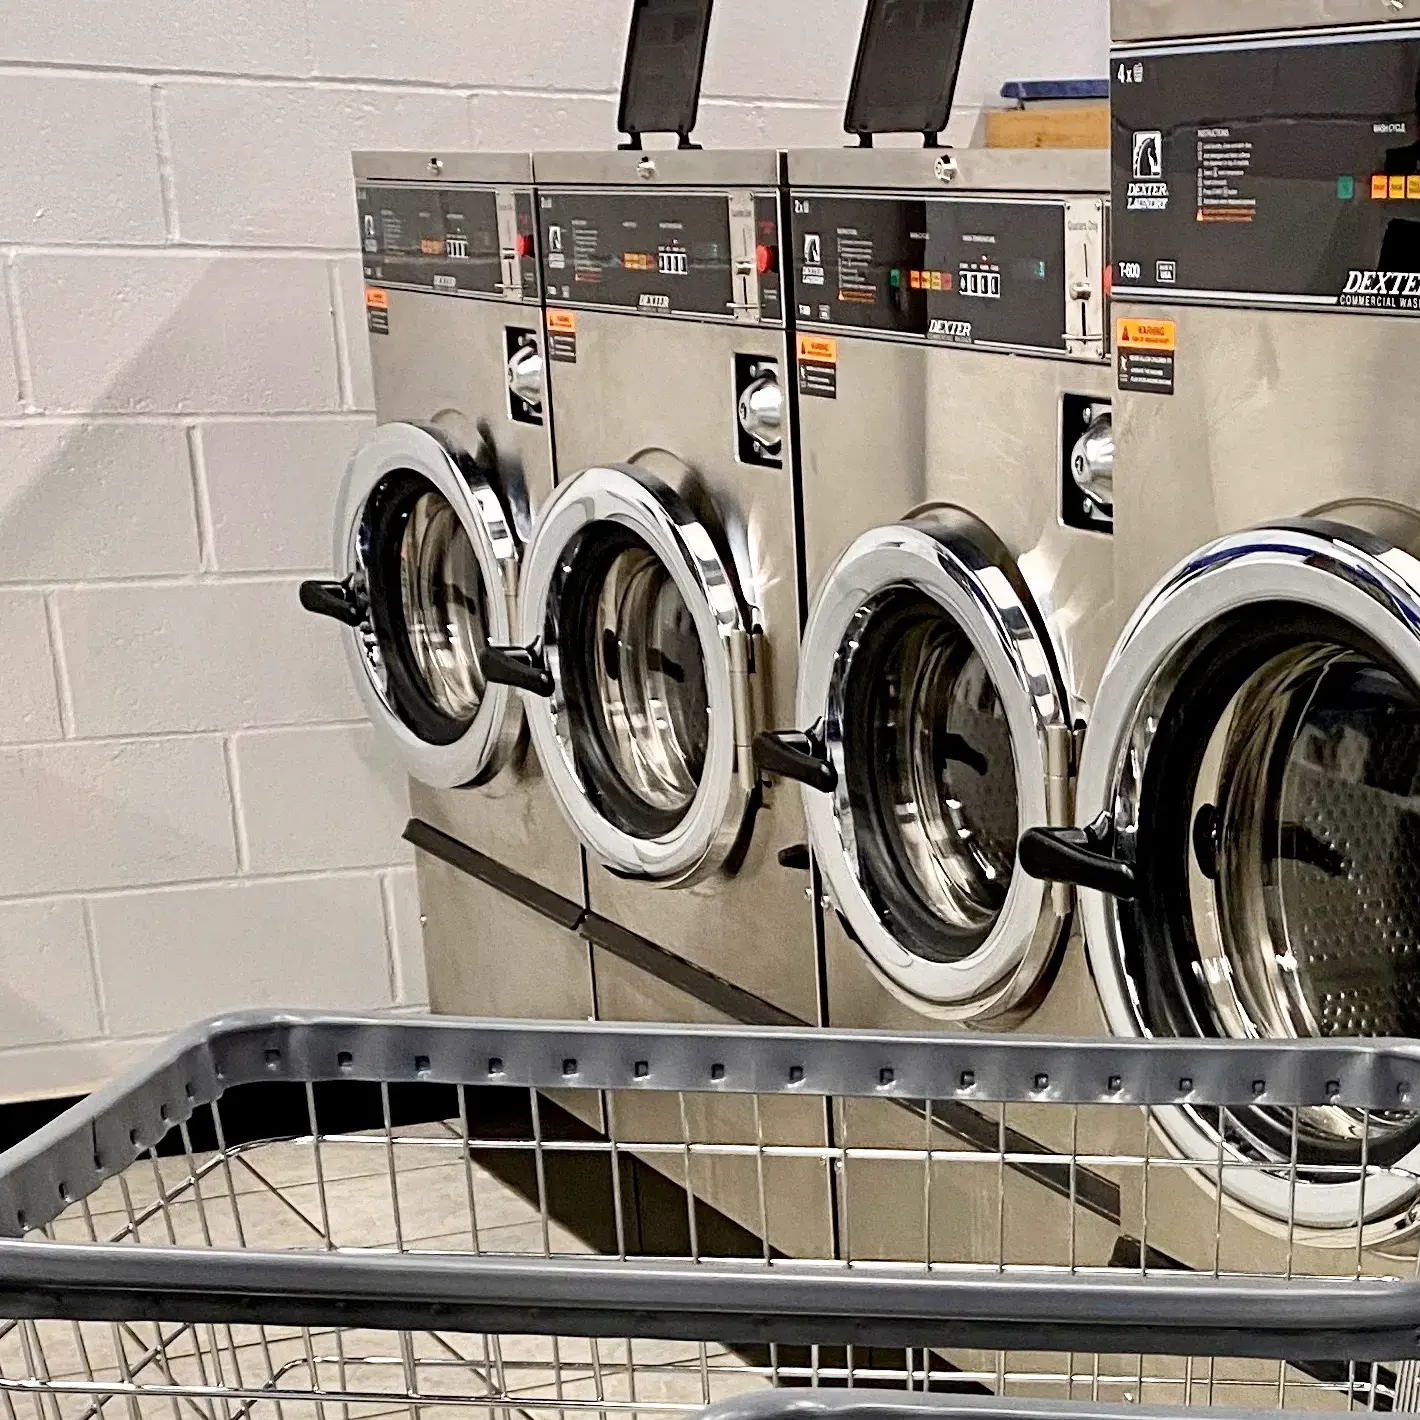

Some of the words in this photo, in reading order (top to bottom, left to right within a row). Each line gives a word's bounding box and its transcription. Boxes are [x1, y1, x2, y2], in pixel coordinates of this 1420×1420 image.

[1127, 183, 1168, 196] DEXTER
[1119, 262, 1141, 279] T-600
[1340, 294, 1396, 307] COMMERCIAL
[929, 319, 972, 337] DEXTER
